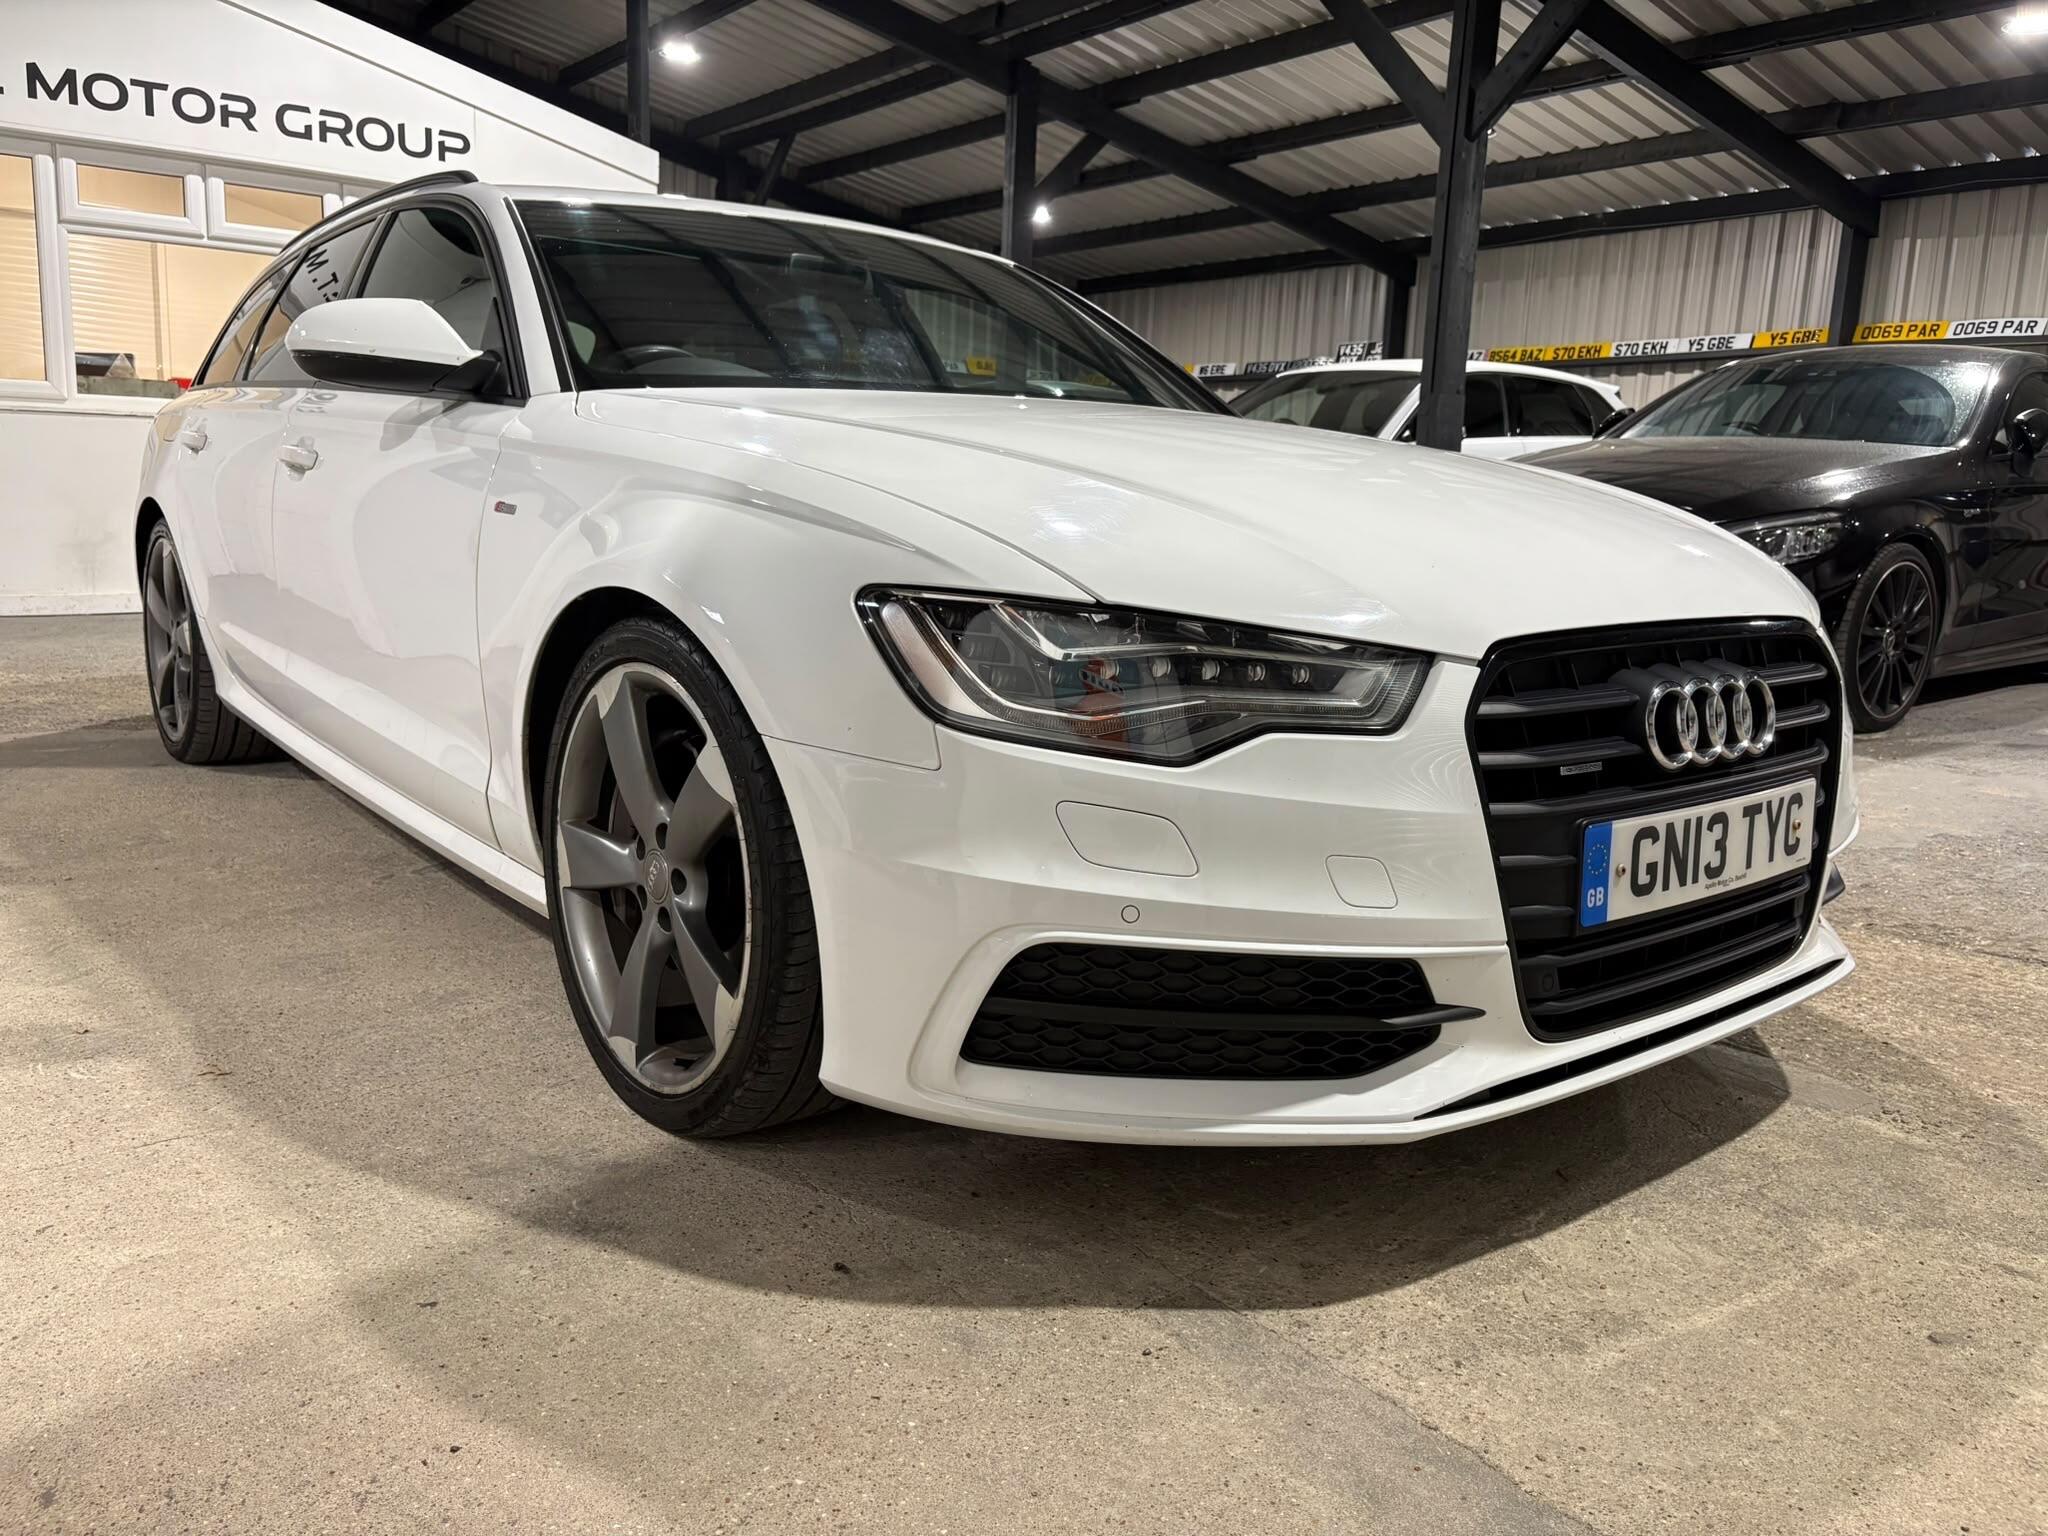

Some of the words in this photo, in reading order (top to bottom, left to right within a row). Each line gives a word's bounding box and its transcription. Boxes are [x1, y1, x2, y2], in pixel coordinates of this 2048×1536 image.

[25, 61, 259, 132] MOTOR
[275, 103, 472, 162] GROUP
[1906, 323, 1940, 338] PAR
[2001, 320, 2039, 334] PAR
[1688, 338, 1704, 352] Y5
[1707, 336, 1736, 350] GBE
[1791, 328, 1824, 344] GBE
[1552, 346, 1576, 360] S70
[1578, 345, 1602, 359] EKH
[1614, 342, 1640, 357] S70
[1641, 341, 1669, 355] EKH
[1629, 810, 1729, 898] GN13
[1742, 791, 1804, 871] TYC
[1587, 886, 1604, 908] GB
